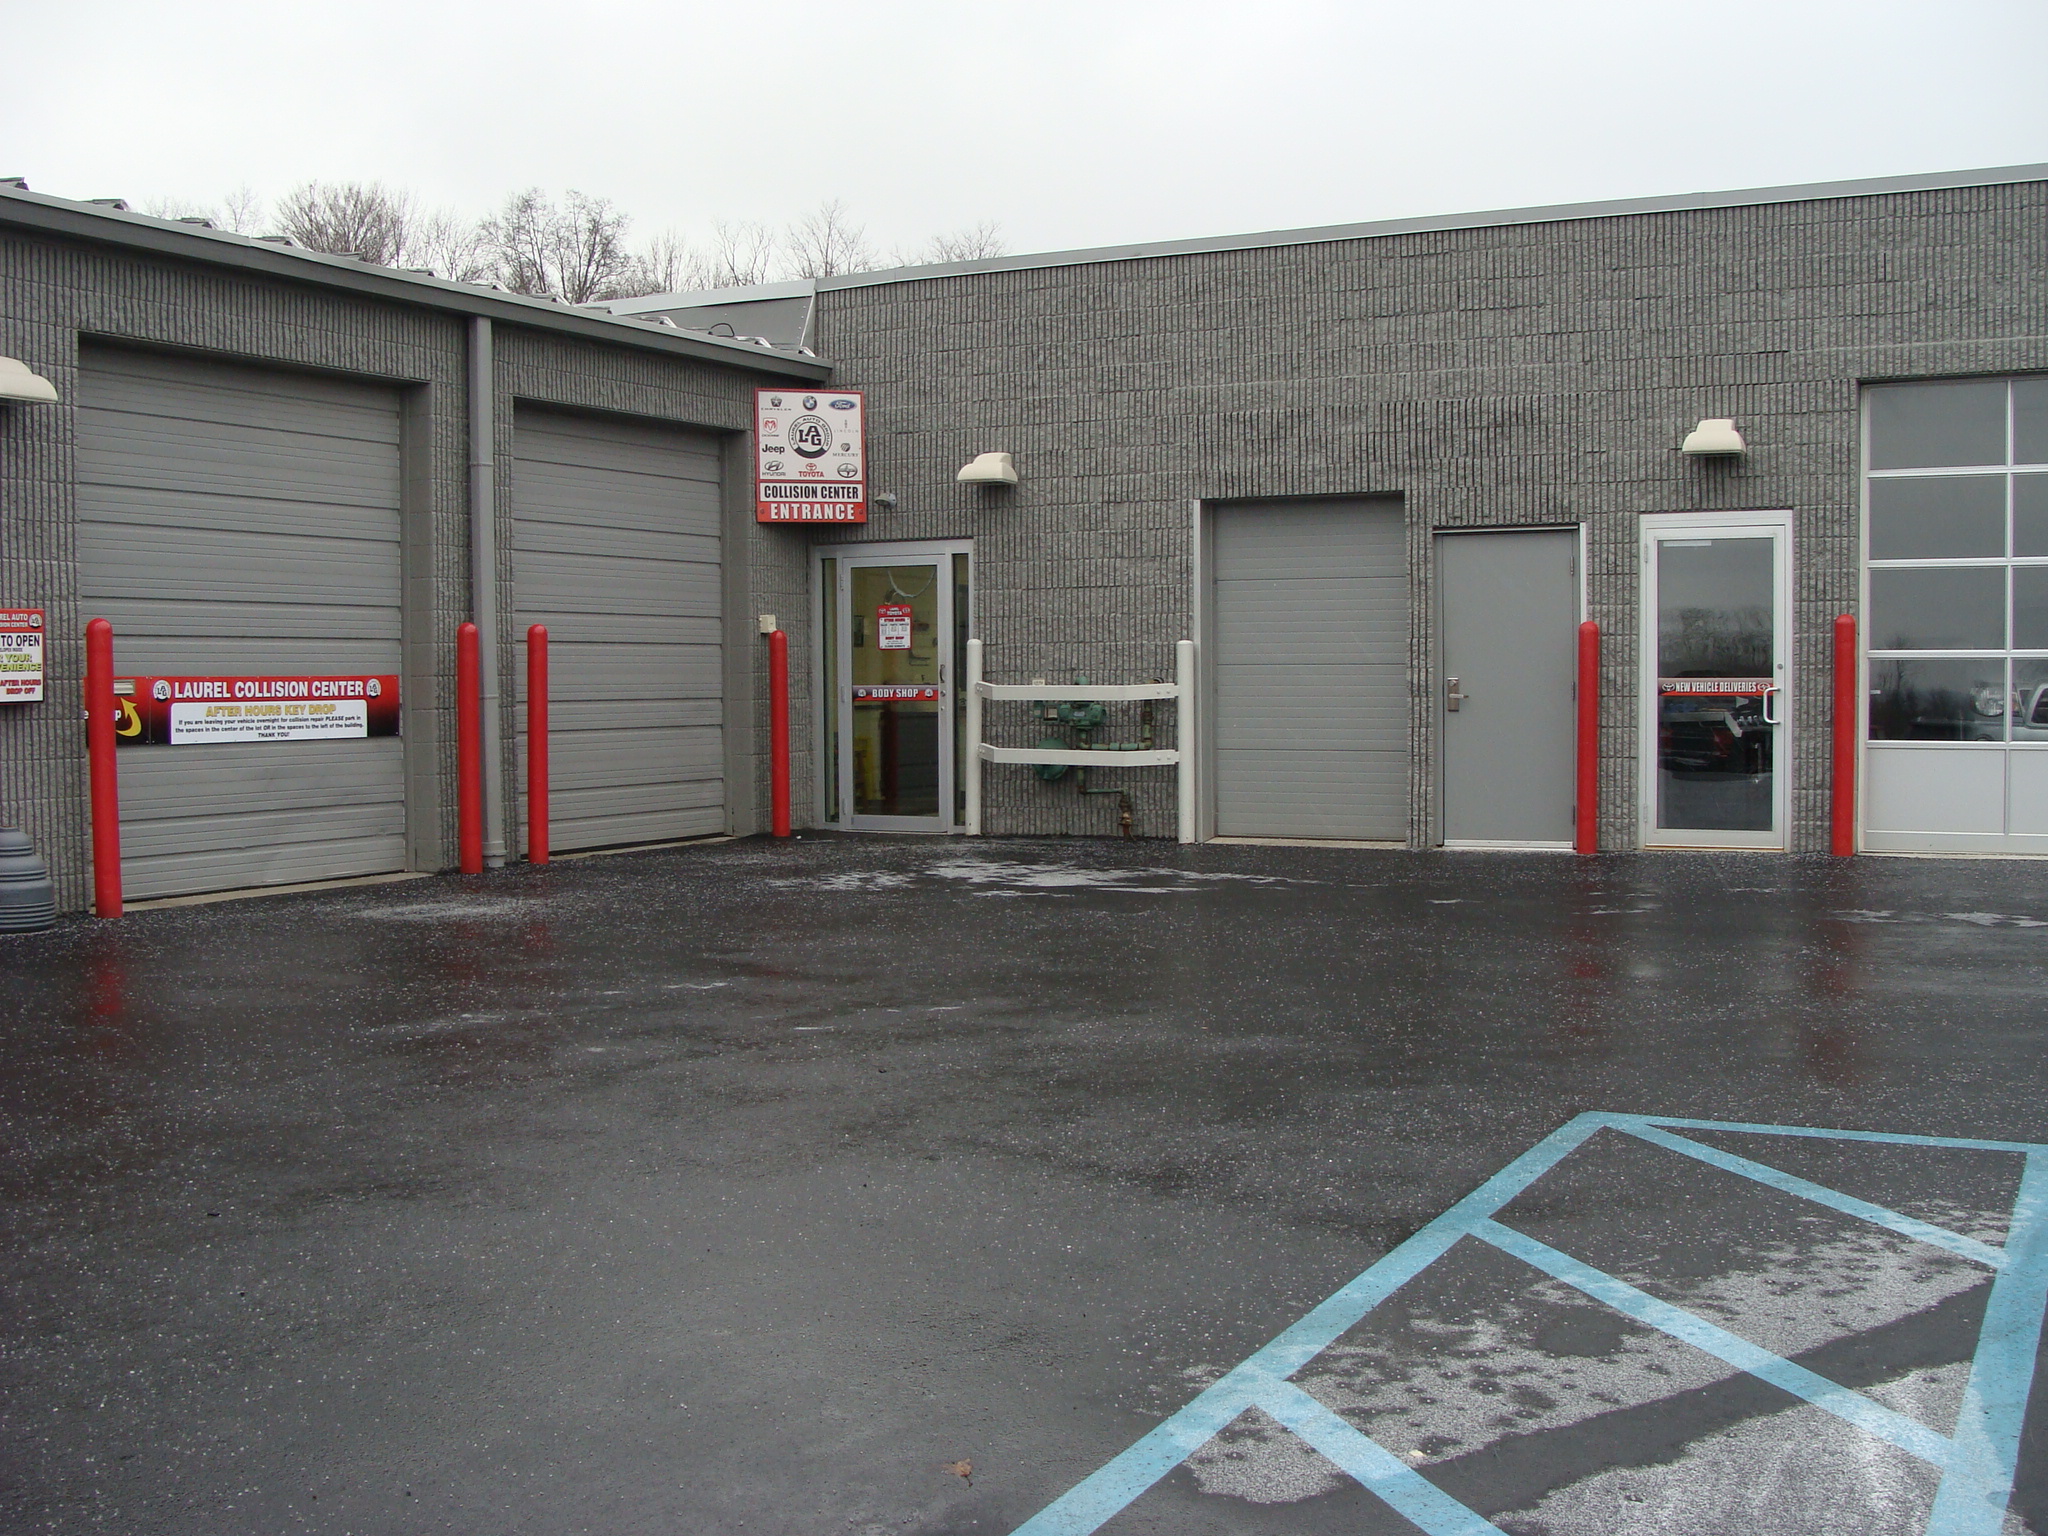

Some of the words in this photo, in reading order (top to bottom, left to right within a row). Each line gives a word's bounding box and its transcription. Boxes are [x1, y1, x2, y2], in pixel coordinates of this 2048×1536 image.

[762, 444, 785, 455] Jeep
[764, 485, 818, 499] COLLISION
[820, 486, 859, 500] CENTER
[770, 503, 855, 520] ENTRANCE
[1, 634, 14, 647] TO
[16, 634, 40, 647] OPEN
[5, 654, 32, 662] YOUR
[174, 682, 231, 698] LAUREL
[234, 681, 308, 698] COLLISION
[312, 680, 364, 696] CENTER
[872, 688, 894, 698] BODY
[896, 688, 918, 698] SHOP
[1676, 682, 1691, 692] NEW
[1692, 682, 1719, 692] VEHICLE
[1720, 682, 1756, 692] DELIVERIES
[206, 706, 242, 717] AFTER
[244, 705, 282, 716] HOURS
[284, 704, 306, 716] KEY
[308, 704, 336, 716] DROP
